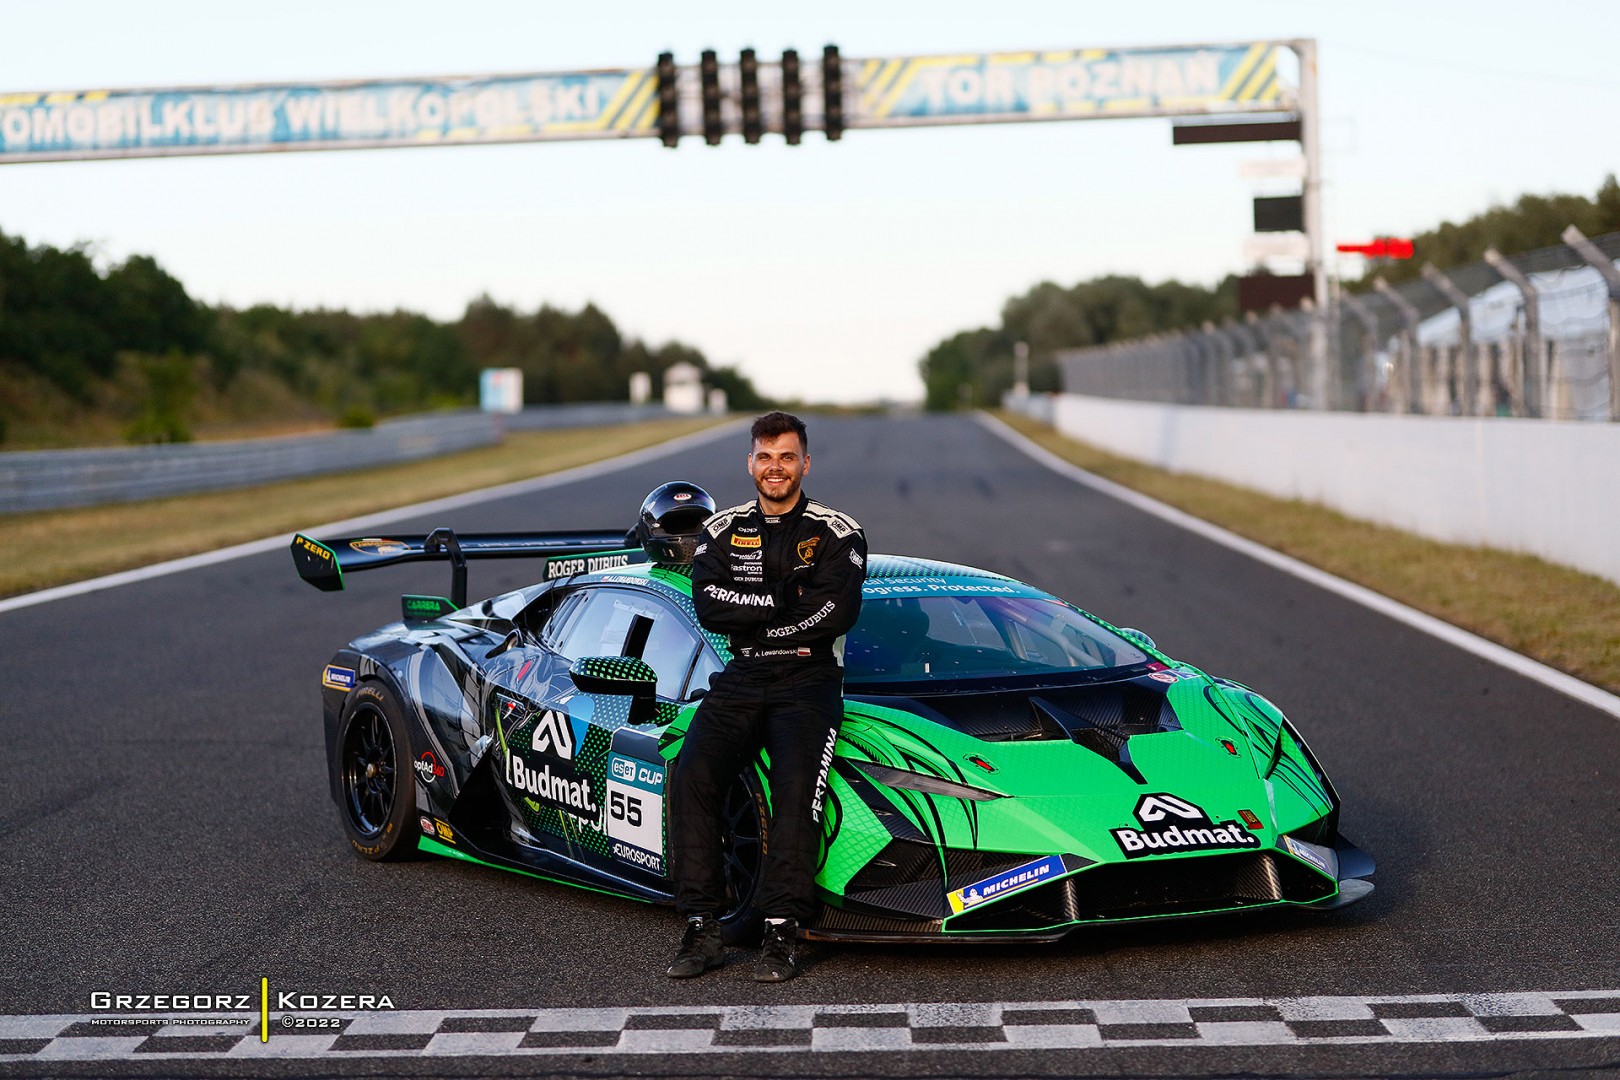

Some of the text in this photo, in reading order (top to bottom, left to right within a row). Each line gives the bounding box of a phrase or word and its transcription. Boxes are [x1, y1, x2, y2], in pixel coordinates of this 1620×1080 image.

[921, 62, 1018, 110] TOR
[285, 84, 600, 131] WIELKOPOLSKI
[712, 517, 729, 532] OMP
[303, 540, 331, 561] ZERO
[548, 559, 585, 578] ROGER
[885, 576, 947, 585] Security
[704, 584, 775, 607] PERTAMINA
[928, 584, 1020, 593] Protected.
[797, 600, 836, 631] DUBUIS
[512, 755, 597, 812] Budmat.
[638, 767, 663, 785] CUP
[811, 727, 837, 823] PERTAMINA
[610, 790, 642, 828] 55
[1116, 823, 1255, 851] Budmat.
[614, 843, 660, 871] EUROSPORT
[983, 864, 1050, 896] MICHELIN
